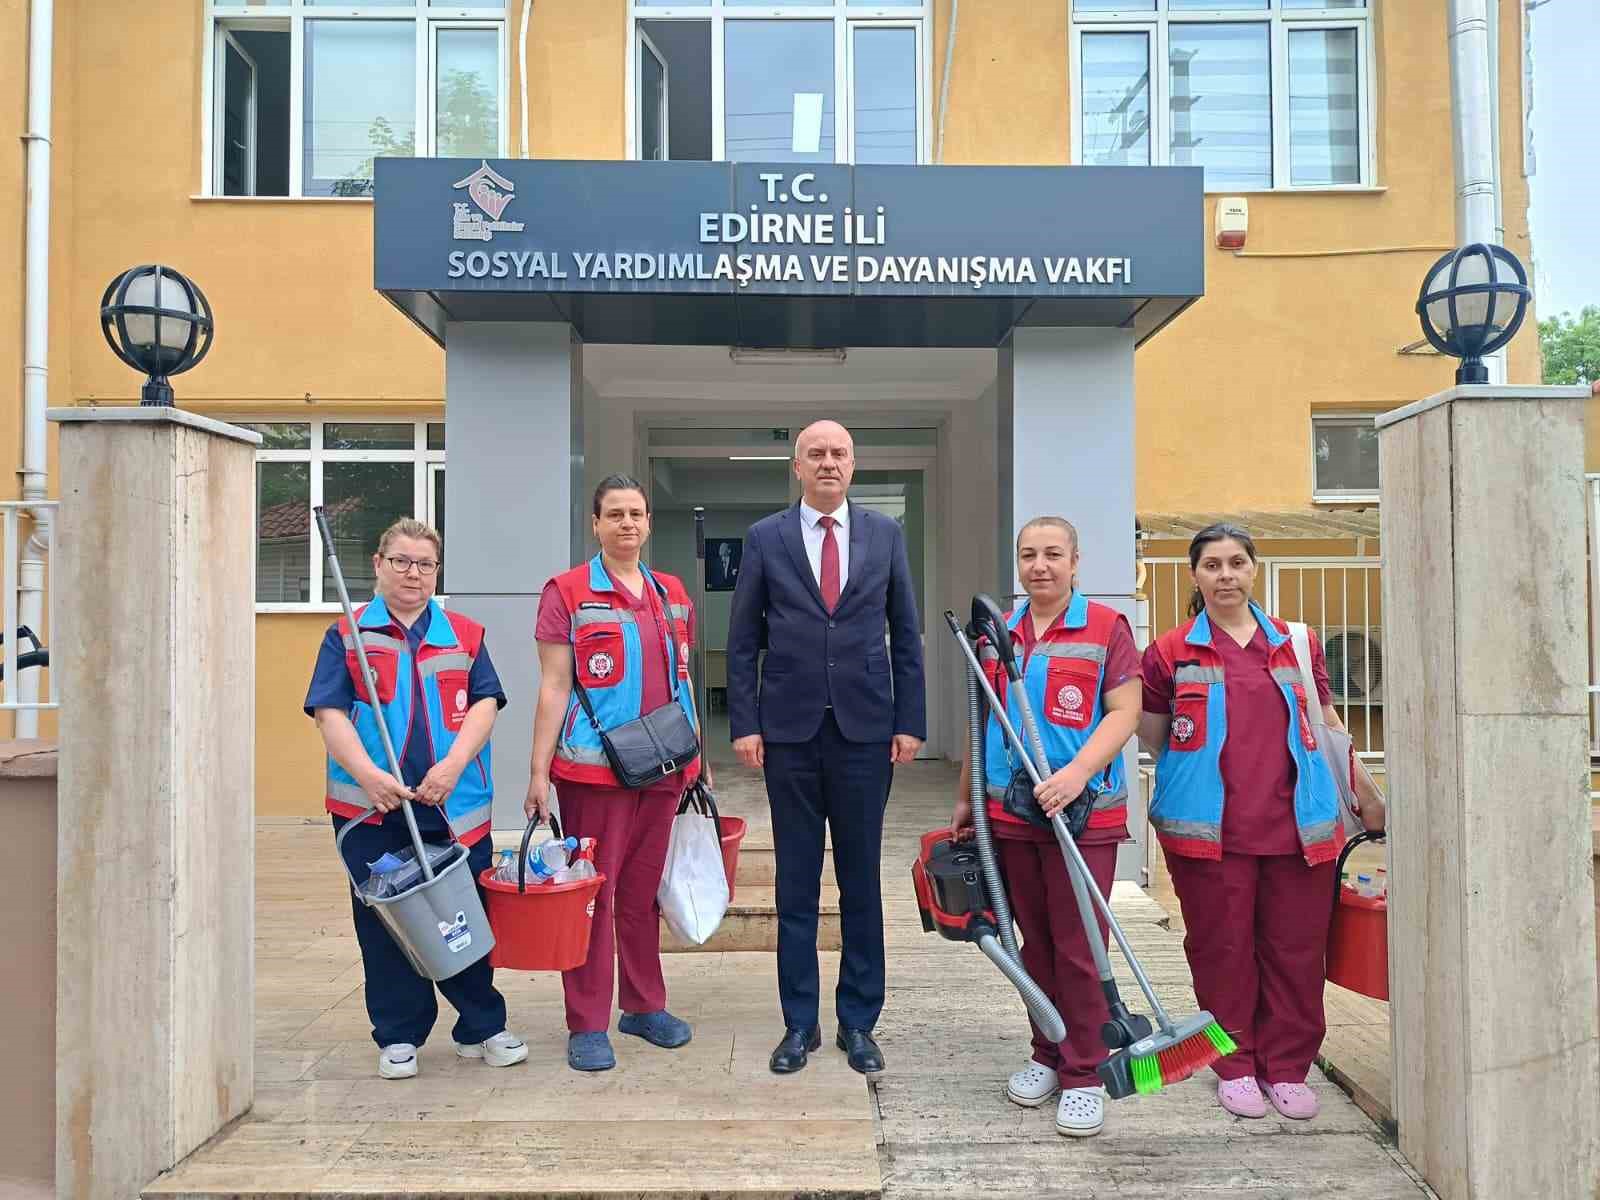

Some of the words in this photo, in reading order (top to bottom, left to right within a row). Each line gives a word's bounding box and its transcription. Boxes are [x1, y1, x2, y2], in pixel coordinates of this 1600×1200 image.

[759, 173, 828, 202] T.C.
[700, 204, 834, 244] EDİRNE
[845, 206, 886, 244] İLİ
[448, 251, 567, 278] SOSYAL
[573, 252, 805, 287] YARDIMLAŞMA
[809, 255, 849, 282] VE
[857, 255, 1037, 289] DAYANIŞMA
[1043, 257, 1131, 283] VAKFI
